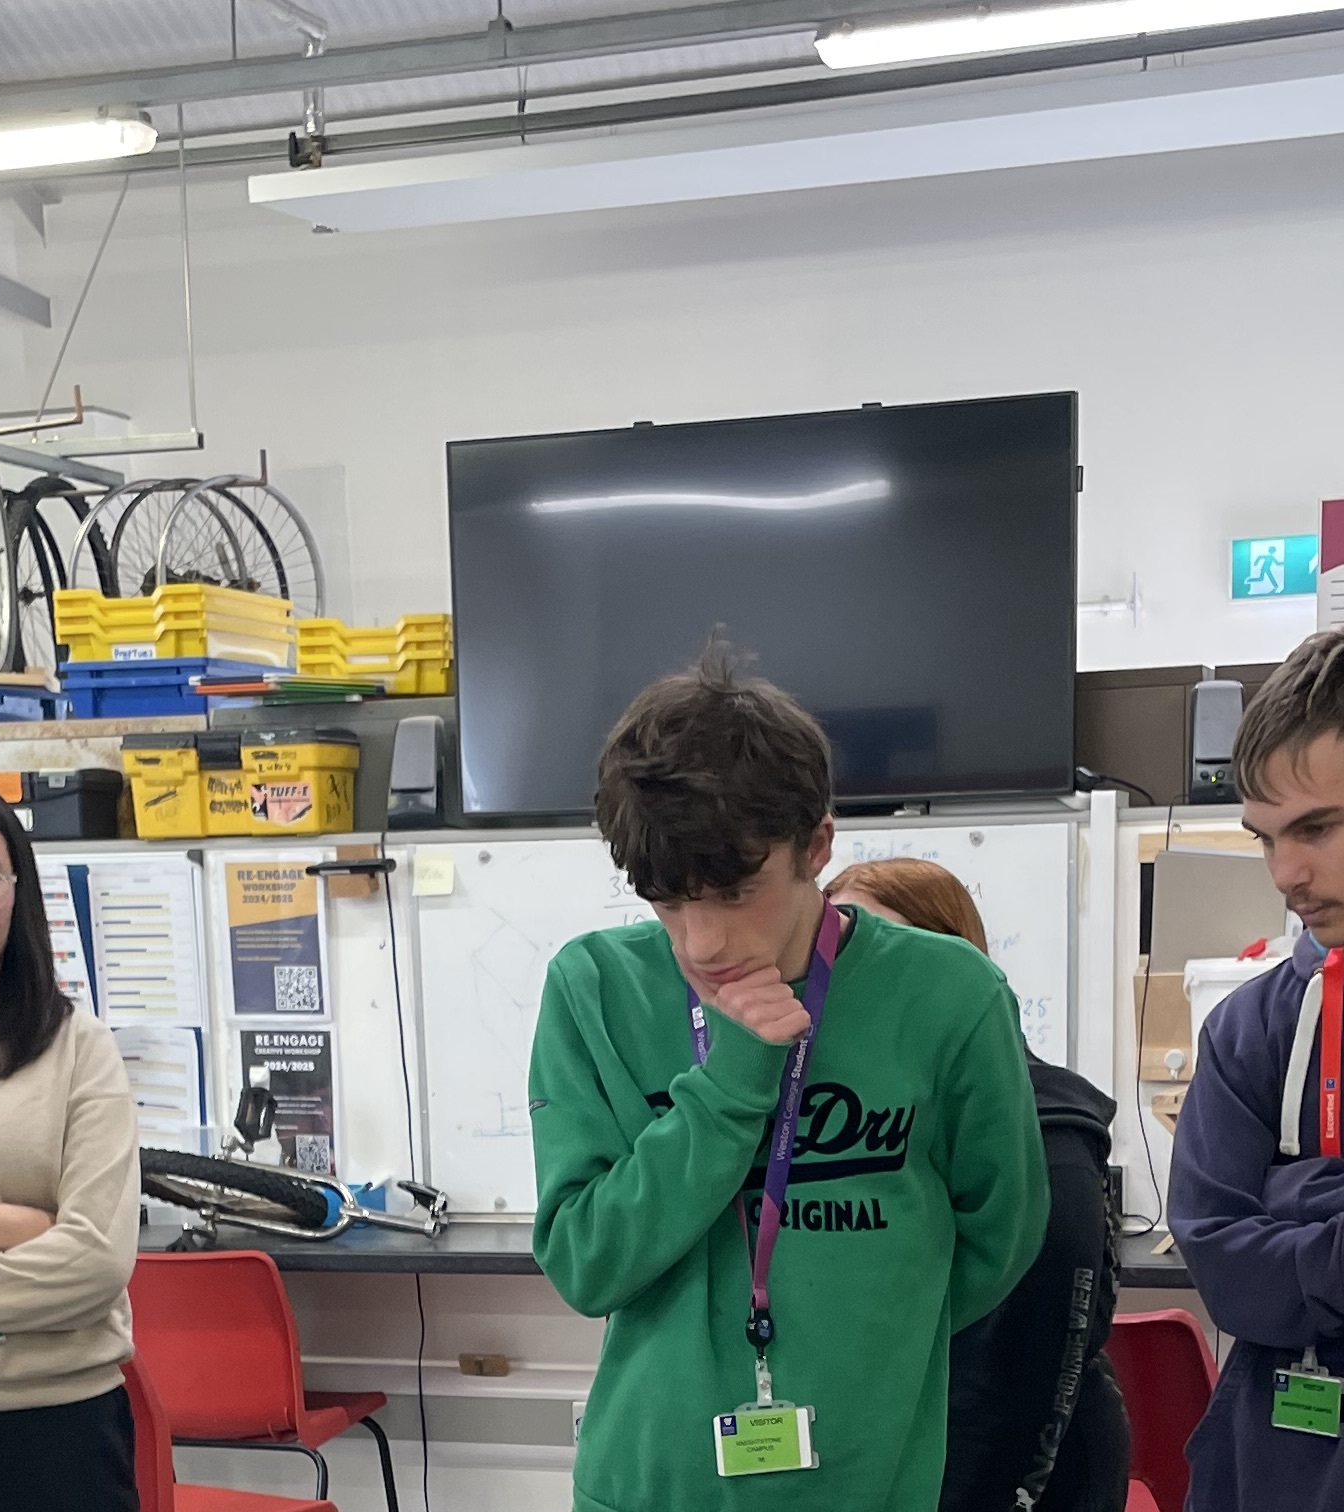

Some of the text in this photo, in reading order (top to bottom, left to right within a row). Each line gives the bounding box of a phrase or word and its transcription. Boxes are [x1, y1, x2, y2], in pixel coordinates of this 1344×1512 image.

[237, 869, 305, 881] RE-ENGAGE
[242, 883, 297, 892] WORKSHOP
[255, 1034, 325, 1047] RE-ENGAGE
[697, 1031, 709, 1065] Westo
[264, 1059, 316, 1073] 2024/2025
[776, 1038, 809, 1162] Weston College Student
[793, 1081, 917, 1158] Dry
[749, 1416, 784, 1427] VISITOR
